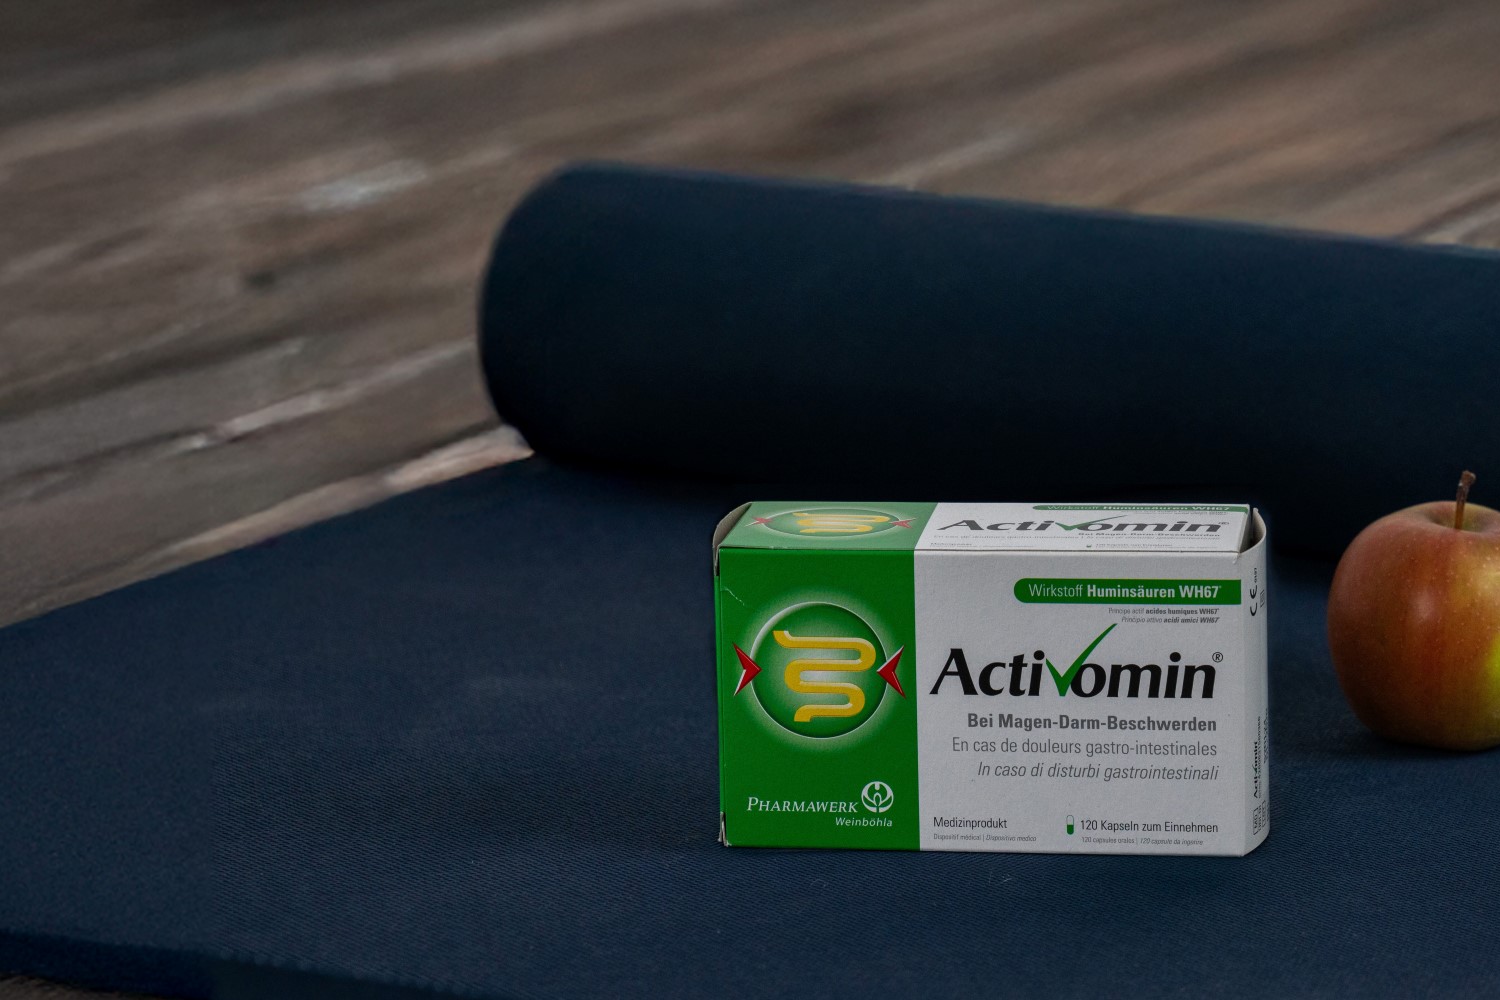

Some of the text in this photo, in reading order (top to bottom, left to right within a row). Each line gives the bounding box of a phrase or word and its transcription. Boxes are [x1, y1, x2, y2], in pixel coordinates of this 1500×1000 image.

[1028, 583, 1083, 597] Wirkstoff
[1087, 583, 1176, 598] Huminsäuren
[1108, 607, 1131, 616] Principe
[1132, 607, 1145, 615] actif
[1145, 607, 1167, 615] acides
[1167, 607, 1198, 616] humiques
[1121, 616, 1146, 624] Principio
[967, 713, 1217, 732] Bei Magen-Darm-Beschwerden
[952, 737, 1217, 757] En cas de douleurs gastro-intestinales
[978, 762, 1220, 782] In caso di disturbi gastrointestinali
[747, 796, 859, 813] PHARMAWERK
[835, 817, 893, 827] Weinböhla
[933, 817, 1008, 830] Medizinprodukt
[1080, 820, 1219, 833] 120 Kapseln zum Einnehmen
[933, 833, 959, 842] Dispositif
[960, 833, 981, 841] médical
[985, 834, 1016, 843] Dispositivo
[1093, 837, 1117, 845] capsules
